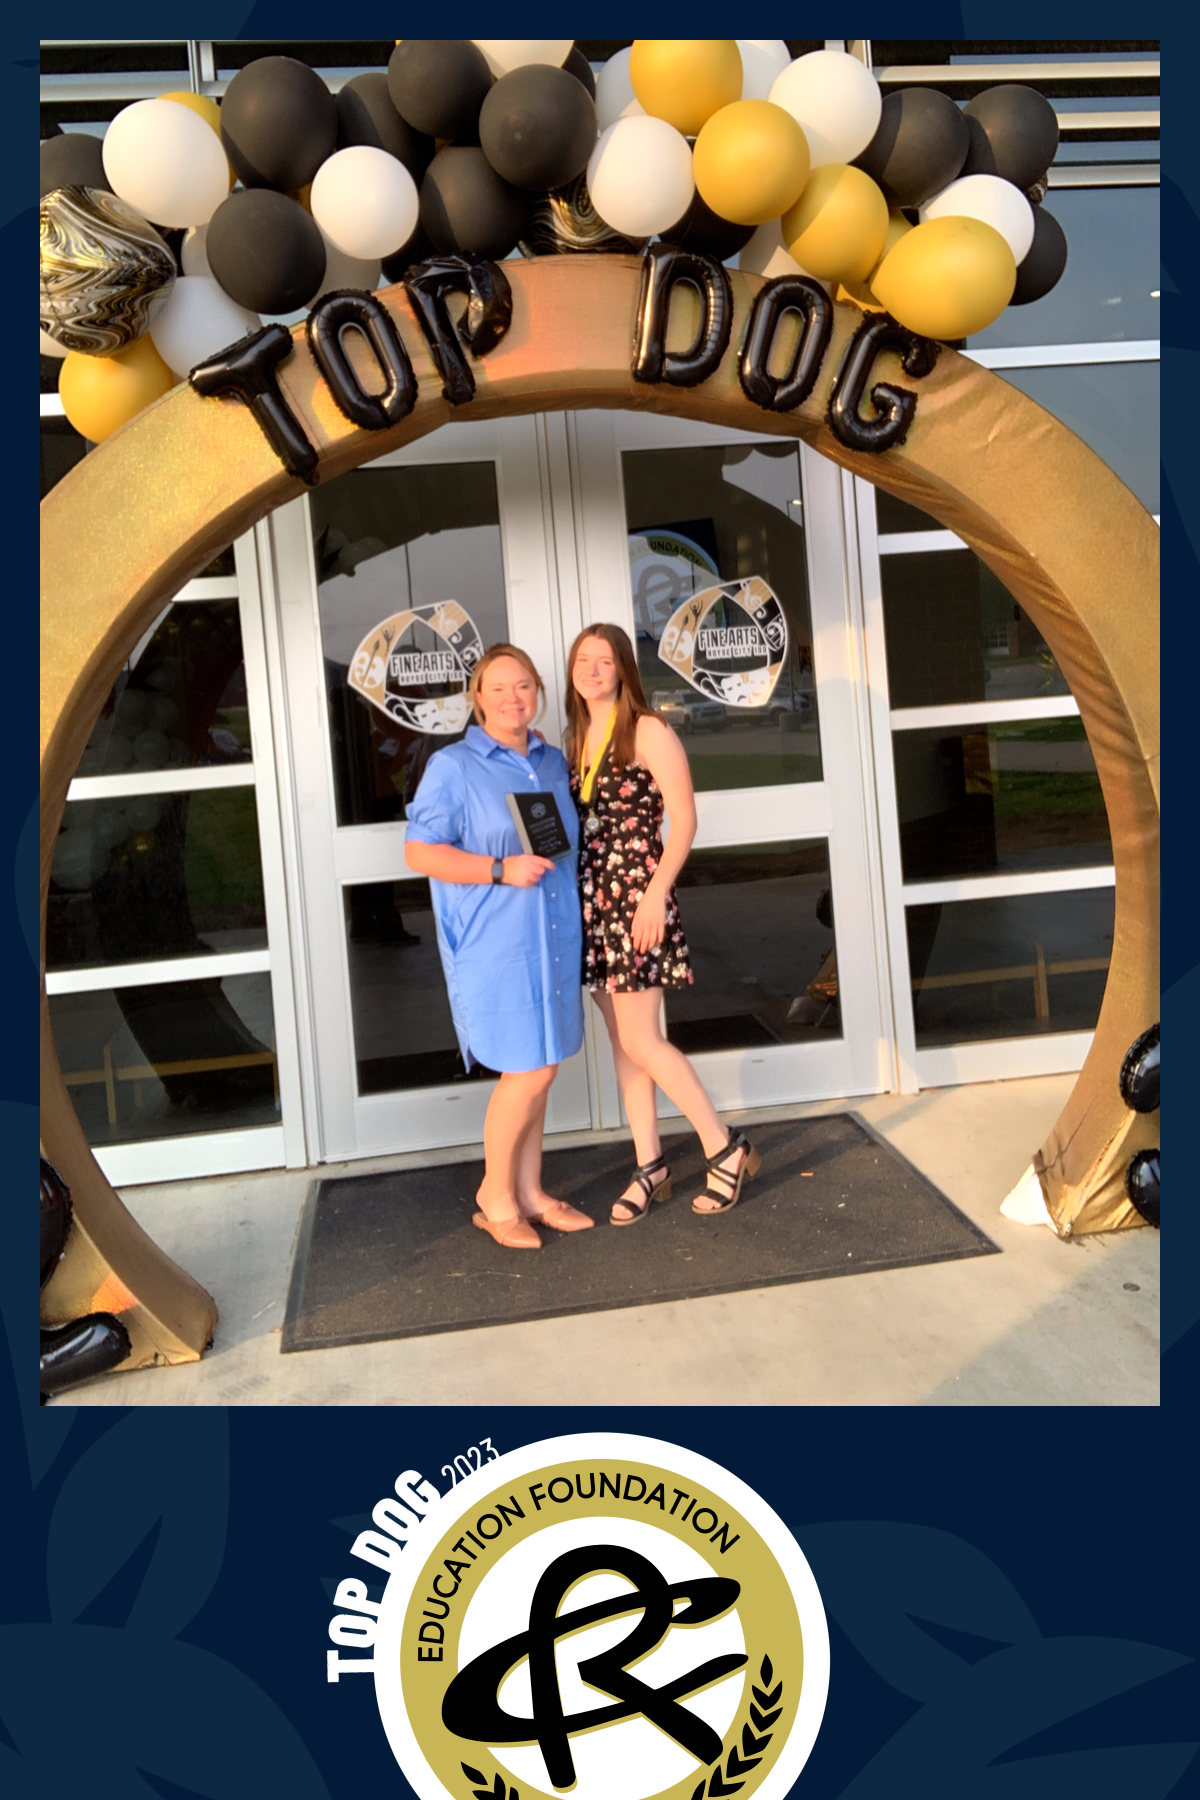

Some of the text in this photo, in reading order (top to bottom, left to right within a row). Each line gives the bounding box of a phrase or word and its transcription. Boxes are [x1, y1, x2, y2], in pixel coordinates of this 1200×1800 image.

[190, 240, 939, 485] TOP DOG
[699, 626, 758, 650] FINE ARTS
[733, 646, 752, 657] CITY
[391, 652, 454, 675] FINE ARTS
